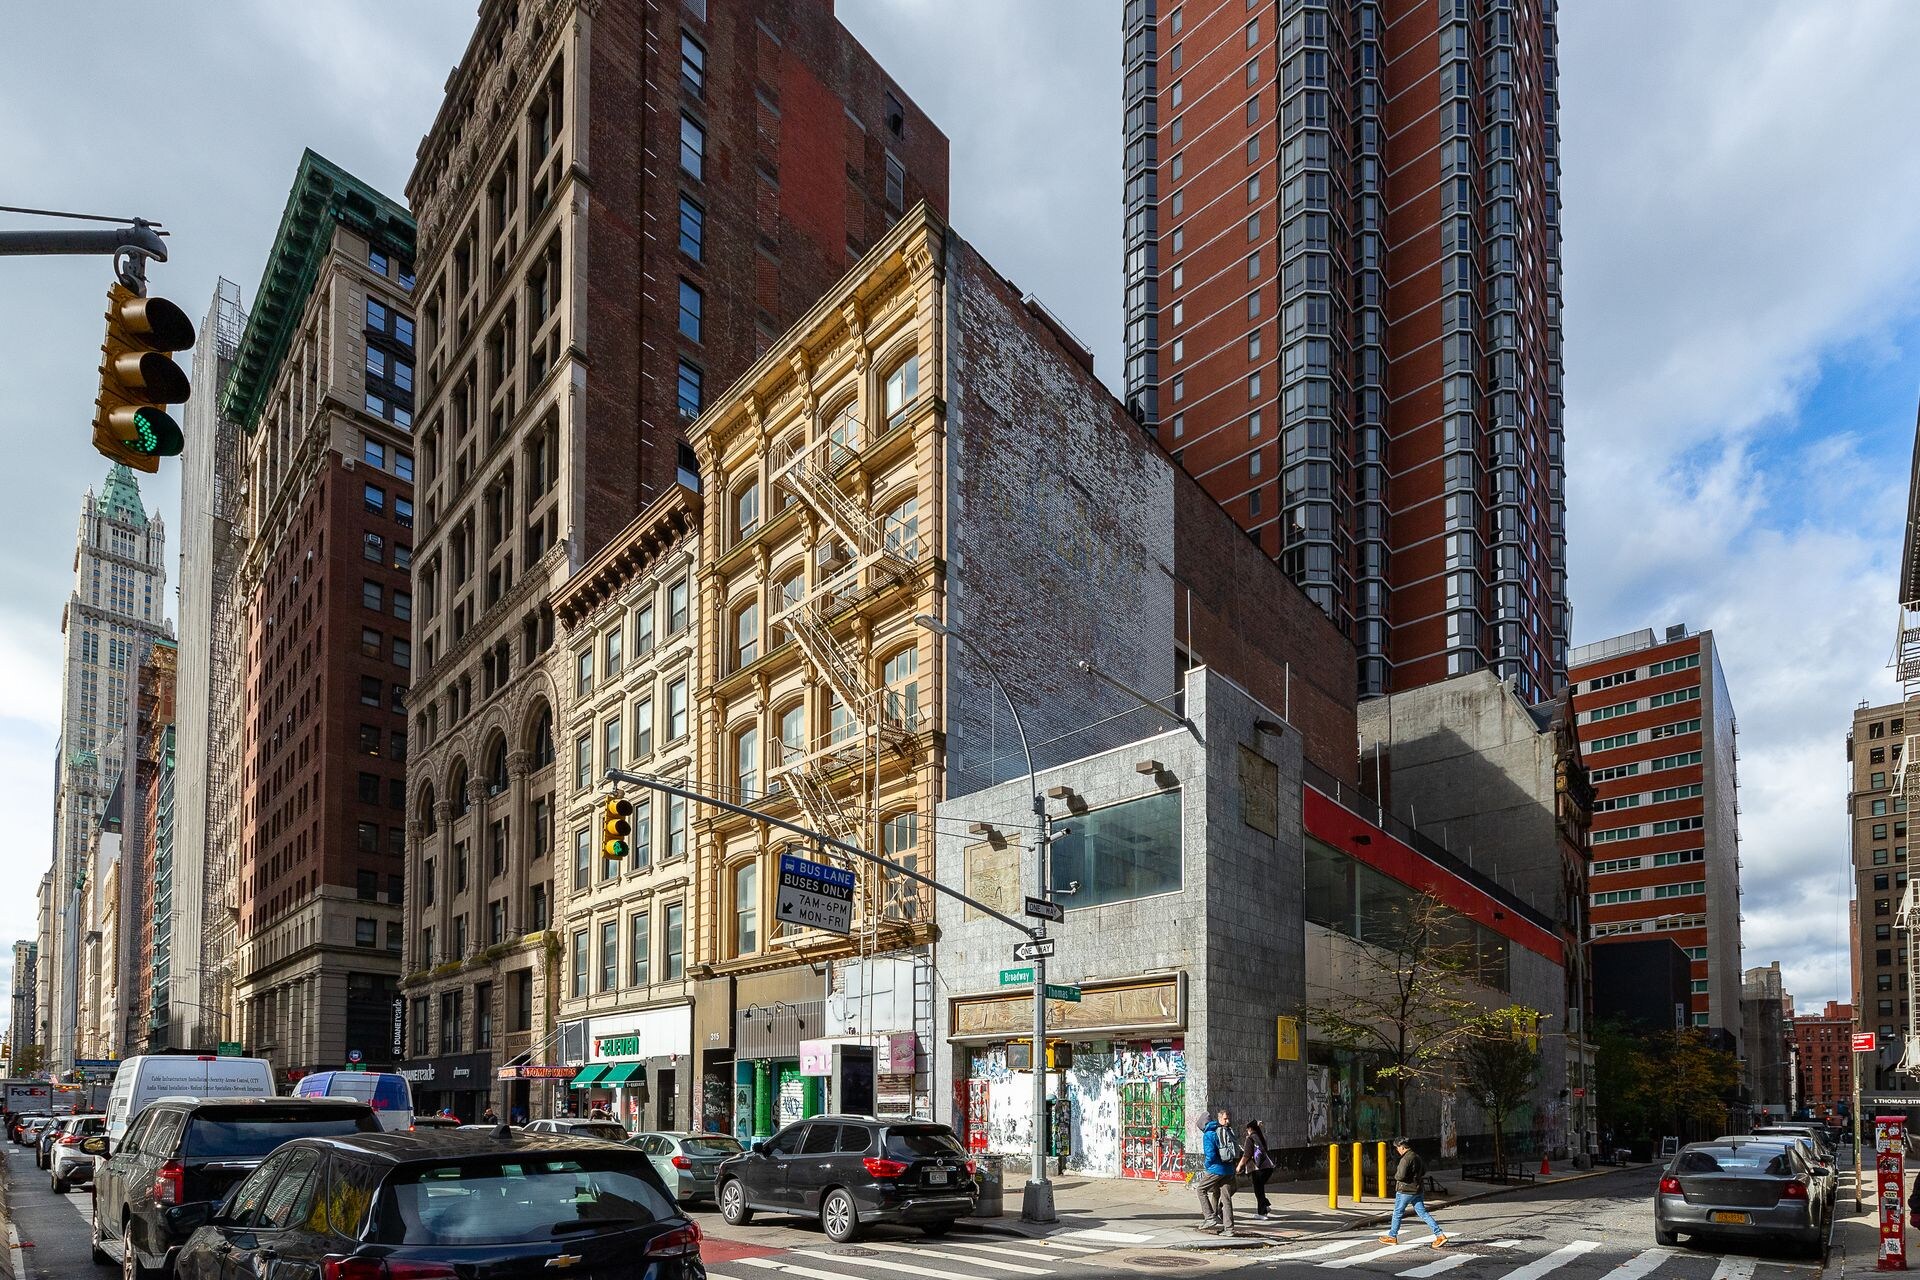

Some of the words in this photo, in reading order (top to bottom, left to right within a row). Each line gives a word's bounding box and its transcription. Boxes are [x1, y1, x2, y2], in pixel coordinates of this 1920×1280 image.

[800, 862, 820, 877] BUS
[823, 868, 851, 885] LANE
[784, 873, 819, 892] BUSES
[822, 884, 849, 899] ONLY
[799, 894, 847, 915] 7AM-6PM
[1029, 904, 1041, 913] ONE
[1045, 906, 1058, 915] WAY
[799, 908, 844, 928] MON-FRI
[1020, 947, 1033, 956] ONE
[1004, 971, 1030, 982] Broadway
[1048, 986, 1069, 999] Thomas
[710, 1032, 720, 1041] 315
[593, 1036, 640, 1058] 7-ELEVEN
[453, 1066, 470, 1079] pharmacy
[523, 1067, 552, 1077] ATOMIC
[552, 1067, 577, 1077] WINGS
[10, 1087, 47, 1097] FedEx
